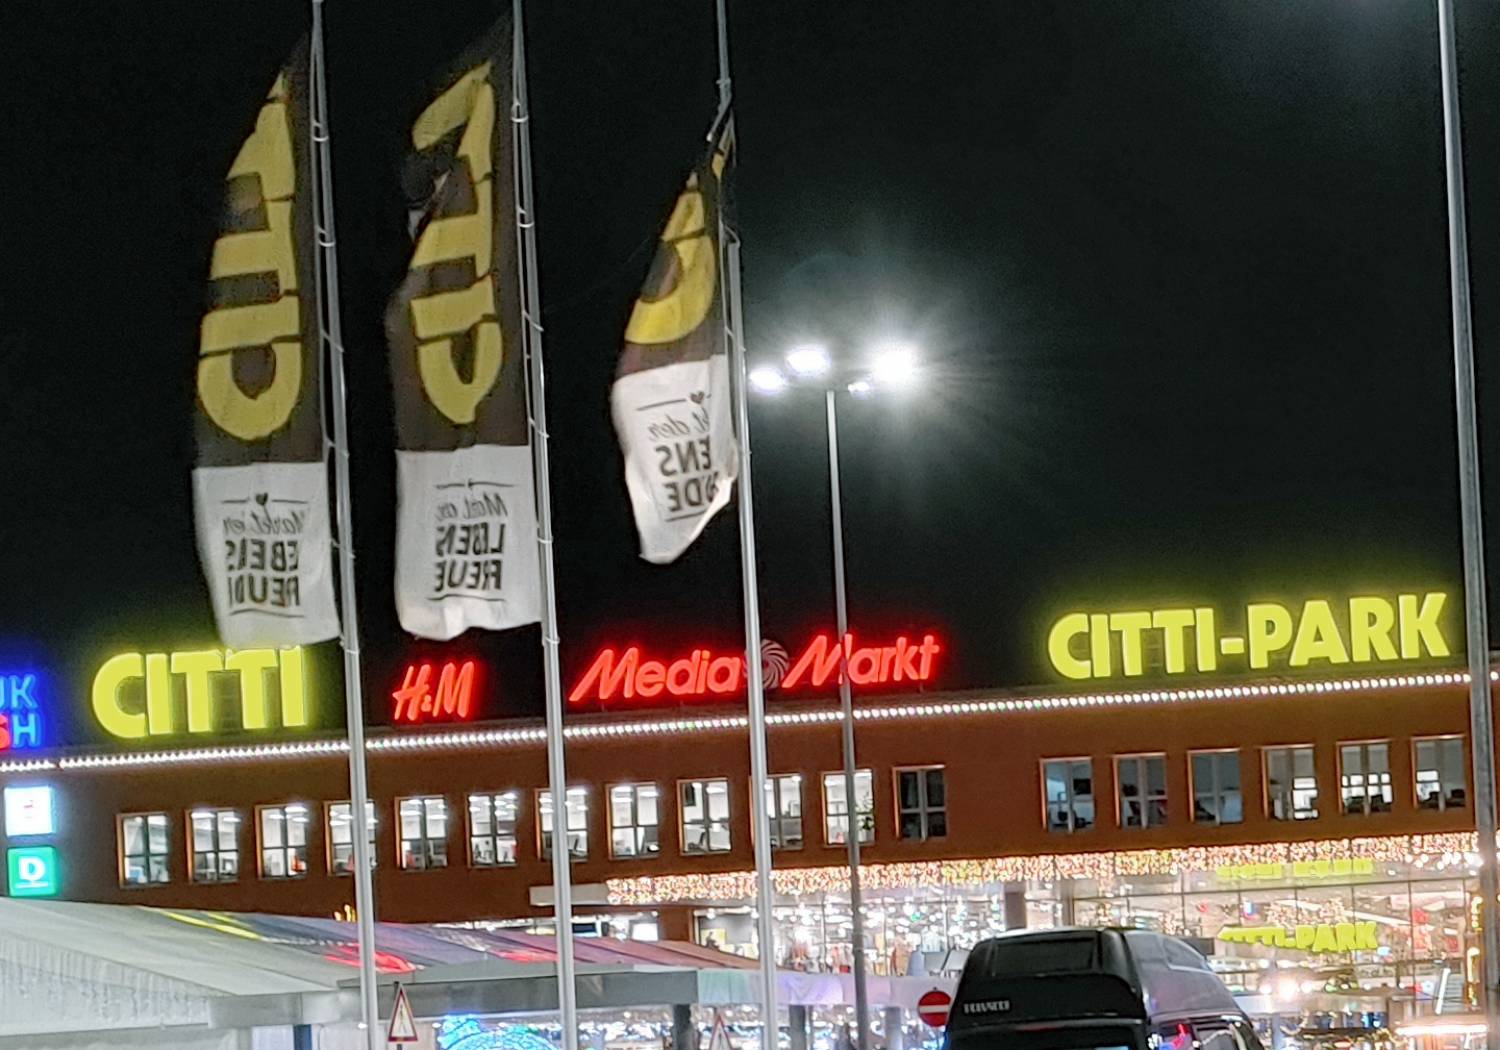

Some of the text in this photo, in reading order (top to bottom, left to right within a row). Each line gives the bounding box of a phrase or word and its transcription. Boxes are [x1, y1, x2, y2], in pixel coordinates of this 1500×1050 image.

[568, 633, 940, 702] Media Markt
[1047, 592, 1451, 679] CITTI-PARK
[91, 645, 308, 739] CITTI
[392, 660, 475, 721] H&M
